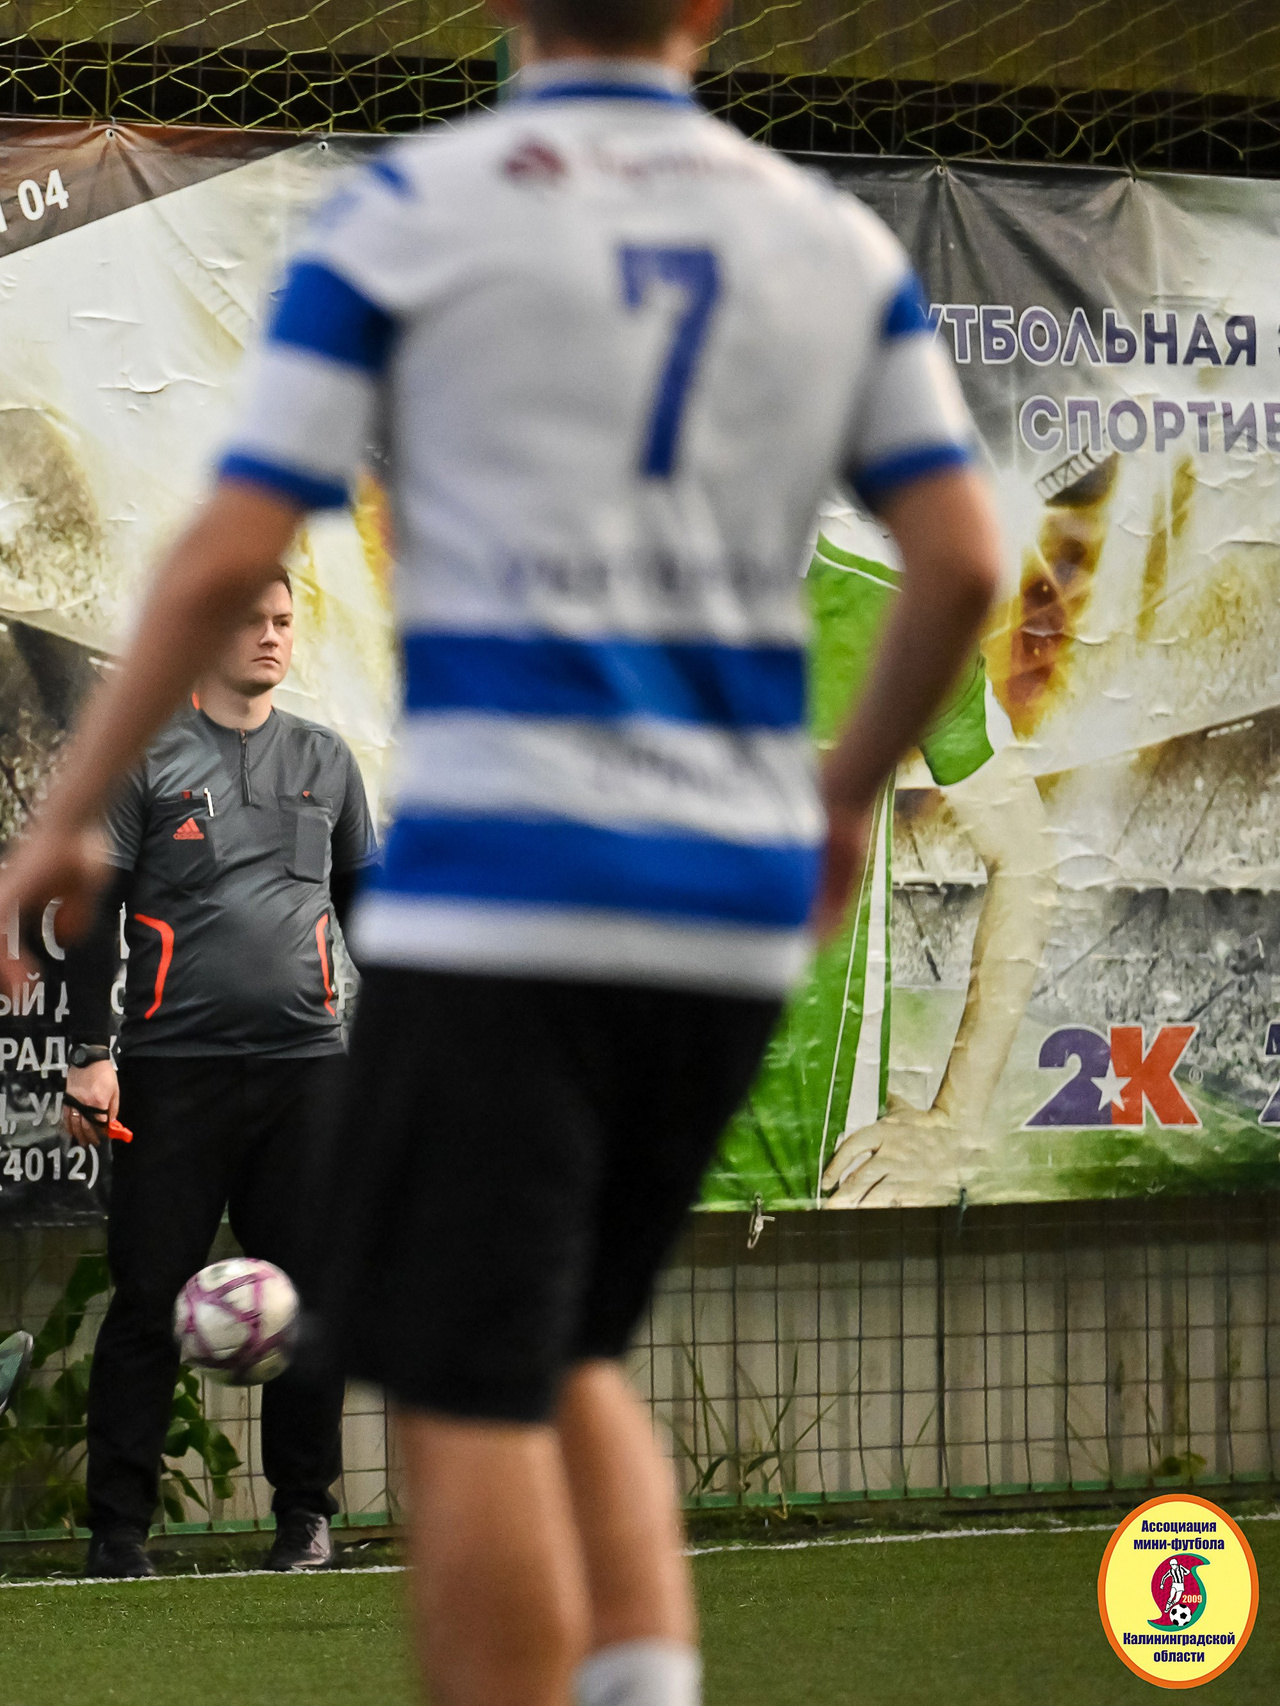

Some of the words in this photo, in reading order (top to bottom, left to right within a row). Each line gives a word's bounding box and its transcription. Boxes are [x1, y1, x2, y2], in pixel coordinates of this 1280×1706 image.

[17, 168, 70, 222] 04
[616, 242, 724, 482] 7
[917, 303, 1258, 366] УТБОЛЬНАЯ
[1022, 1022, 1203, 1130] 2K
